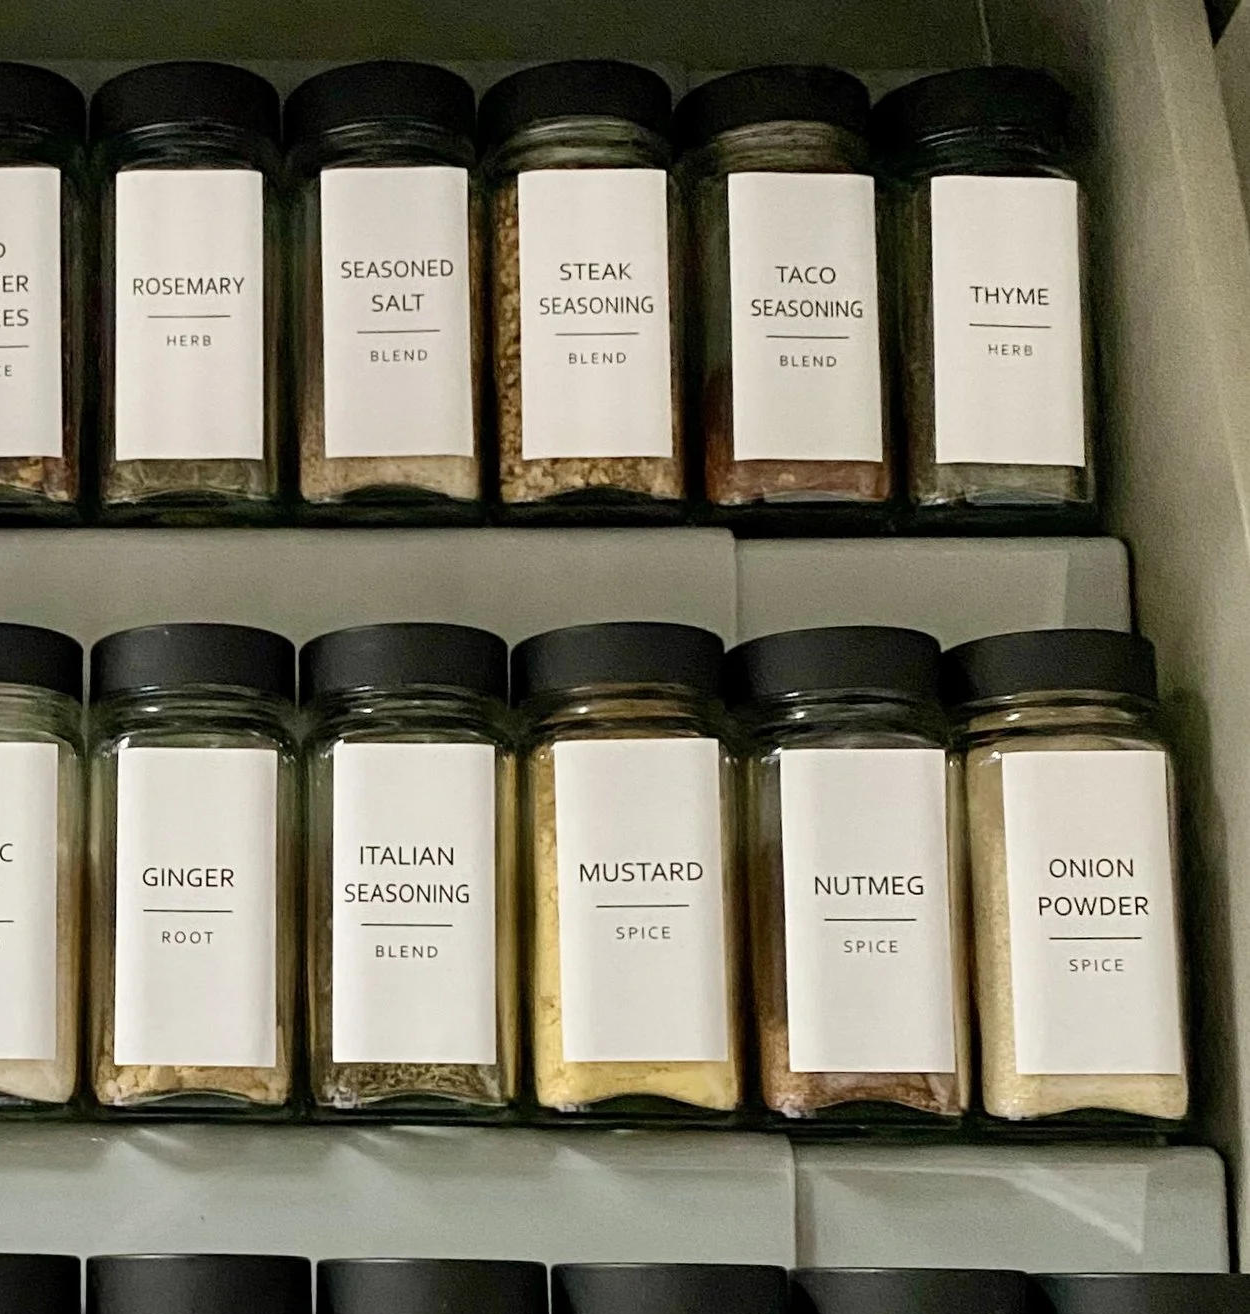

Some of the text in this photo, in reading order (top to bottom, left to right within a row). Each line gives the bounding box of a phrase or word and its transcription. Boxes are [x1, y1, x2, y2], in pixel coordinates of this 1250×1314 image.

[340, 258, 455, 280] SEASONED
[559, 262, 633, 282] STEAK
[774, 265, 837, 285] TACO
[132, 276, 245, 297] ROSEMARY
[968, 285, 1051, 307] THYME
[371, 293, 426, 313] SALT
[539, 295, 655, 316] SEASONING
[750, 298, 864, 320] SEASONING
[166, 334, 212, 348] HERB
[987, 343, 1034, 357] HERB
[370, 348, 428, 363] BLEND
[568, 351, 627, 365] BLEND
[779, 354, 838, 369] BLEND
[359, 845, 455, 867] ITALIAN
[141, 866, 235, 889] GINGER
[579, 861, 704, 884] MUSTARD
[1048, 857, 1135, 879] ONION
[343, 882, 470, 904] SEASONING
[814, 875, 925, 896] NUTMEG
[1038, 895, 1150, 917] POWDER
[161, 930, 215, 945] ROOT
[615, 925, 671, 941] SPICE
[375, 944, 439, 959] BLEND
[843, 939, 899, 954] SPICE
[1068, 958, 1125, 973] SPICE
